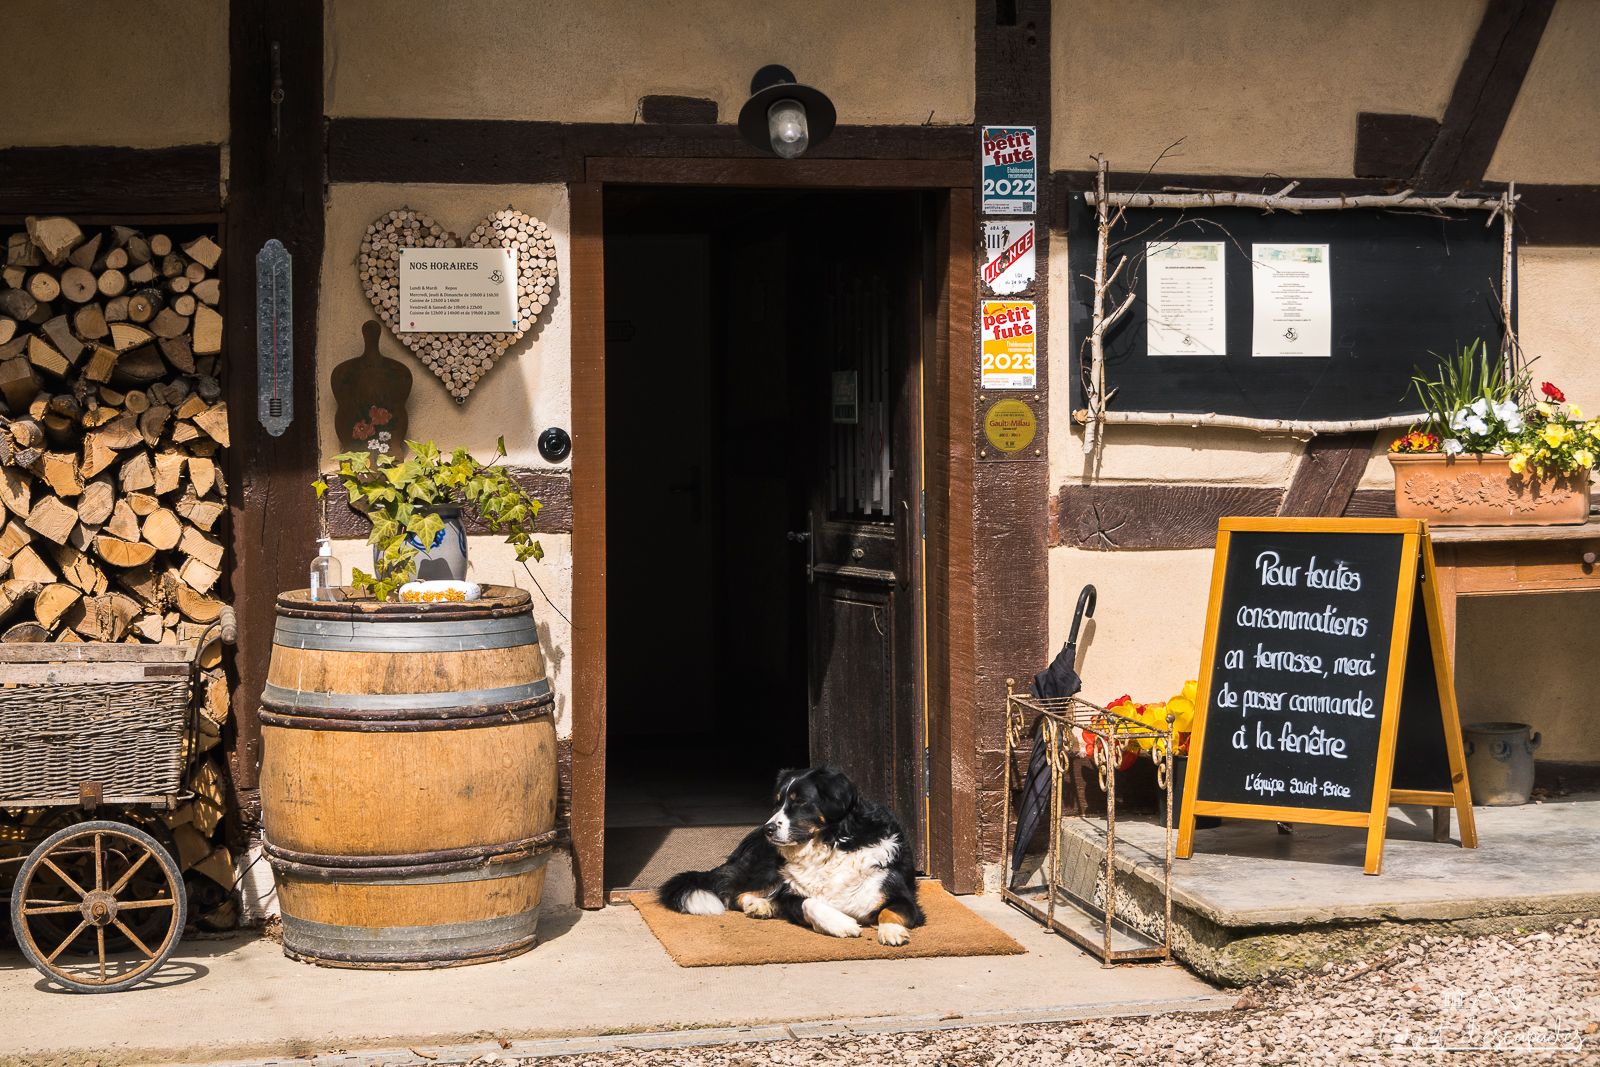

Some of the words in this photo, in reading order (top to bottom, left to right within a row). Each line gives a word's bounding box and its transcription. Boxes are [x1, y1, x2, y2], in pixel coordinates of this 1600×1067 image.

[984, 132, 1031, 156] petit
[993, 147, 1034, 166] futé
[984, 179, 1036, 196] 2022
[409, 262, 428, 271] NOS
[430, 262, 479, 271] HORAIRES
[986, 232, 1031, 283] LICNCE
[983, 306, 1031, 331] petit
[993, 321, 1034, 341] futé
[983, 353, 1035, 370] 2023
[1256, 551, 1301, 586] Pour
[1304, 556, 1362, 592] toutes
[1236, 605, 1369, 638] consommations
[1224, 649, 1244, 670] en
[1254, 643, 1329, 679] terrasse,
[1333, 653, 1376, 677] merci
[1217, 682, 1239, 709] de
[1242, 688, 1288, 718] passer
[1289, 690, 1376, 719] commande
[1232, 725, 1248, 750] à
[1256, 721, 1273, 750] la
[1277, 722, 1348, 759] fenêtre
[1245, 774, 1285, 797] L'équipe
[1289, 776, 1351, 798] Saint-Brice
